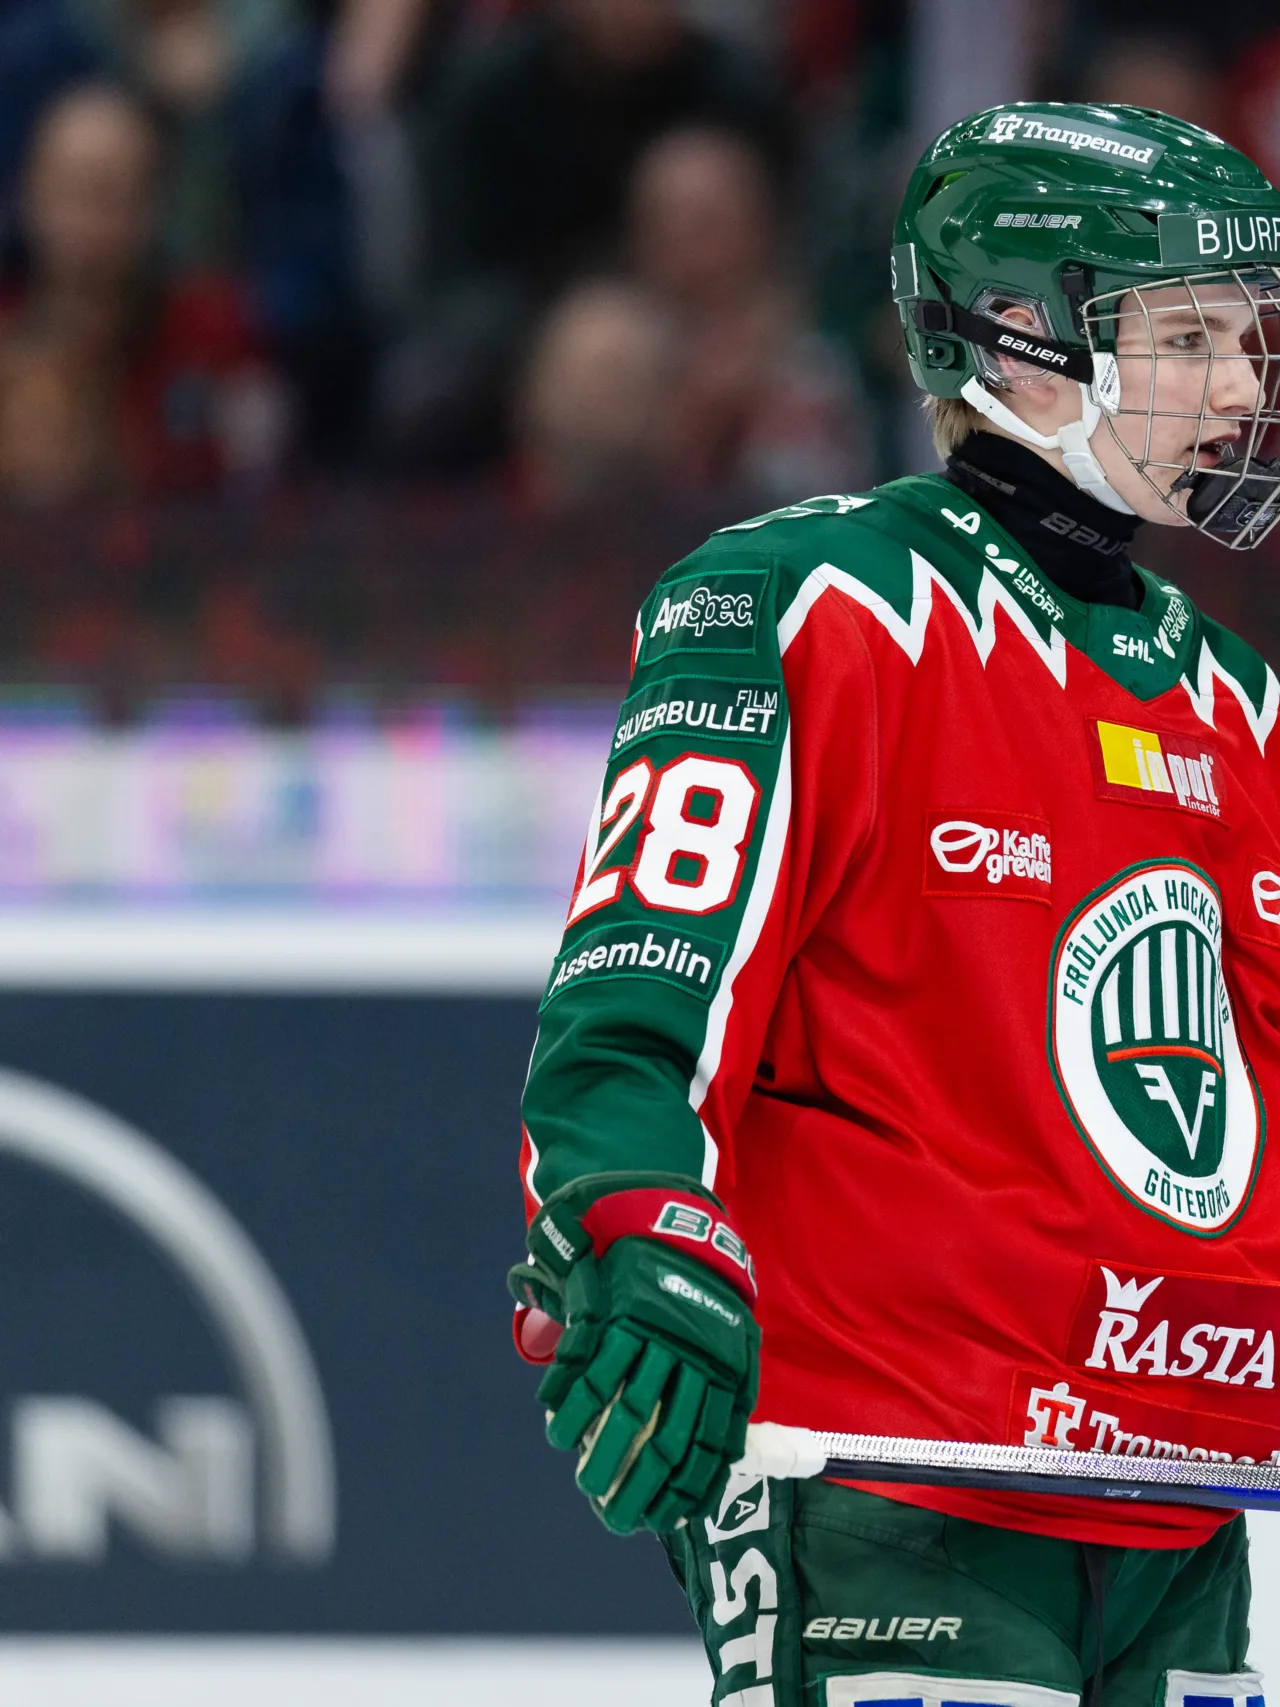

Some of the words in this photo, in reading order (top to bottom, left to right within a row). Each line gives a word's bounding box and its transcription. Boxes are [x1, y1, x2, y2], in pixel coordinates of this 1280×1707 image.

[1022, 120, 1154, 164] Tranpenad
[993, 213, 1082, 229] BAUER
[997, 334, 1069, 366] BAUER
[1012, 578, 1063, 622] SPORT
[1161, 595, 1183, 632] INTER
[1169, 604, 1190, 642] SPORT
[1112, 633, 1155, 665] SHL
[737, 689, 778, 710] FILM
[614, 700, 776, 750] SILVERBULLET
[1132, 738, 1219, 807] input
[565, 751, 762, 931] 28
[1003, 828, 1051, 864] Kaffe
[985, 853, 1052, 885] greven
[1063, 884, 1158, 1006] FRÖLUNDA
[1164, 879, 1221, 943] HOCKEY
[547, 932, 712, 997] Assemblin
[1144, 1167, 1230, 1219] GÖTEBORG
[1085, 1310, 1276, 1390] RASTA
[802, 1615, 963, 1643] BAUER
